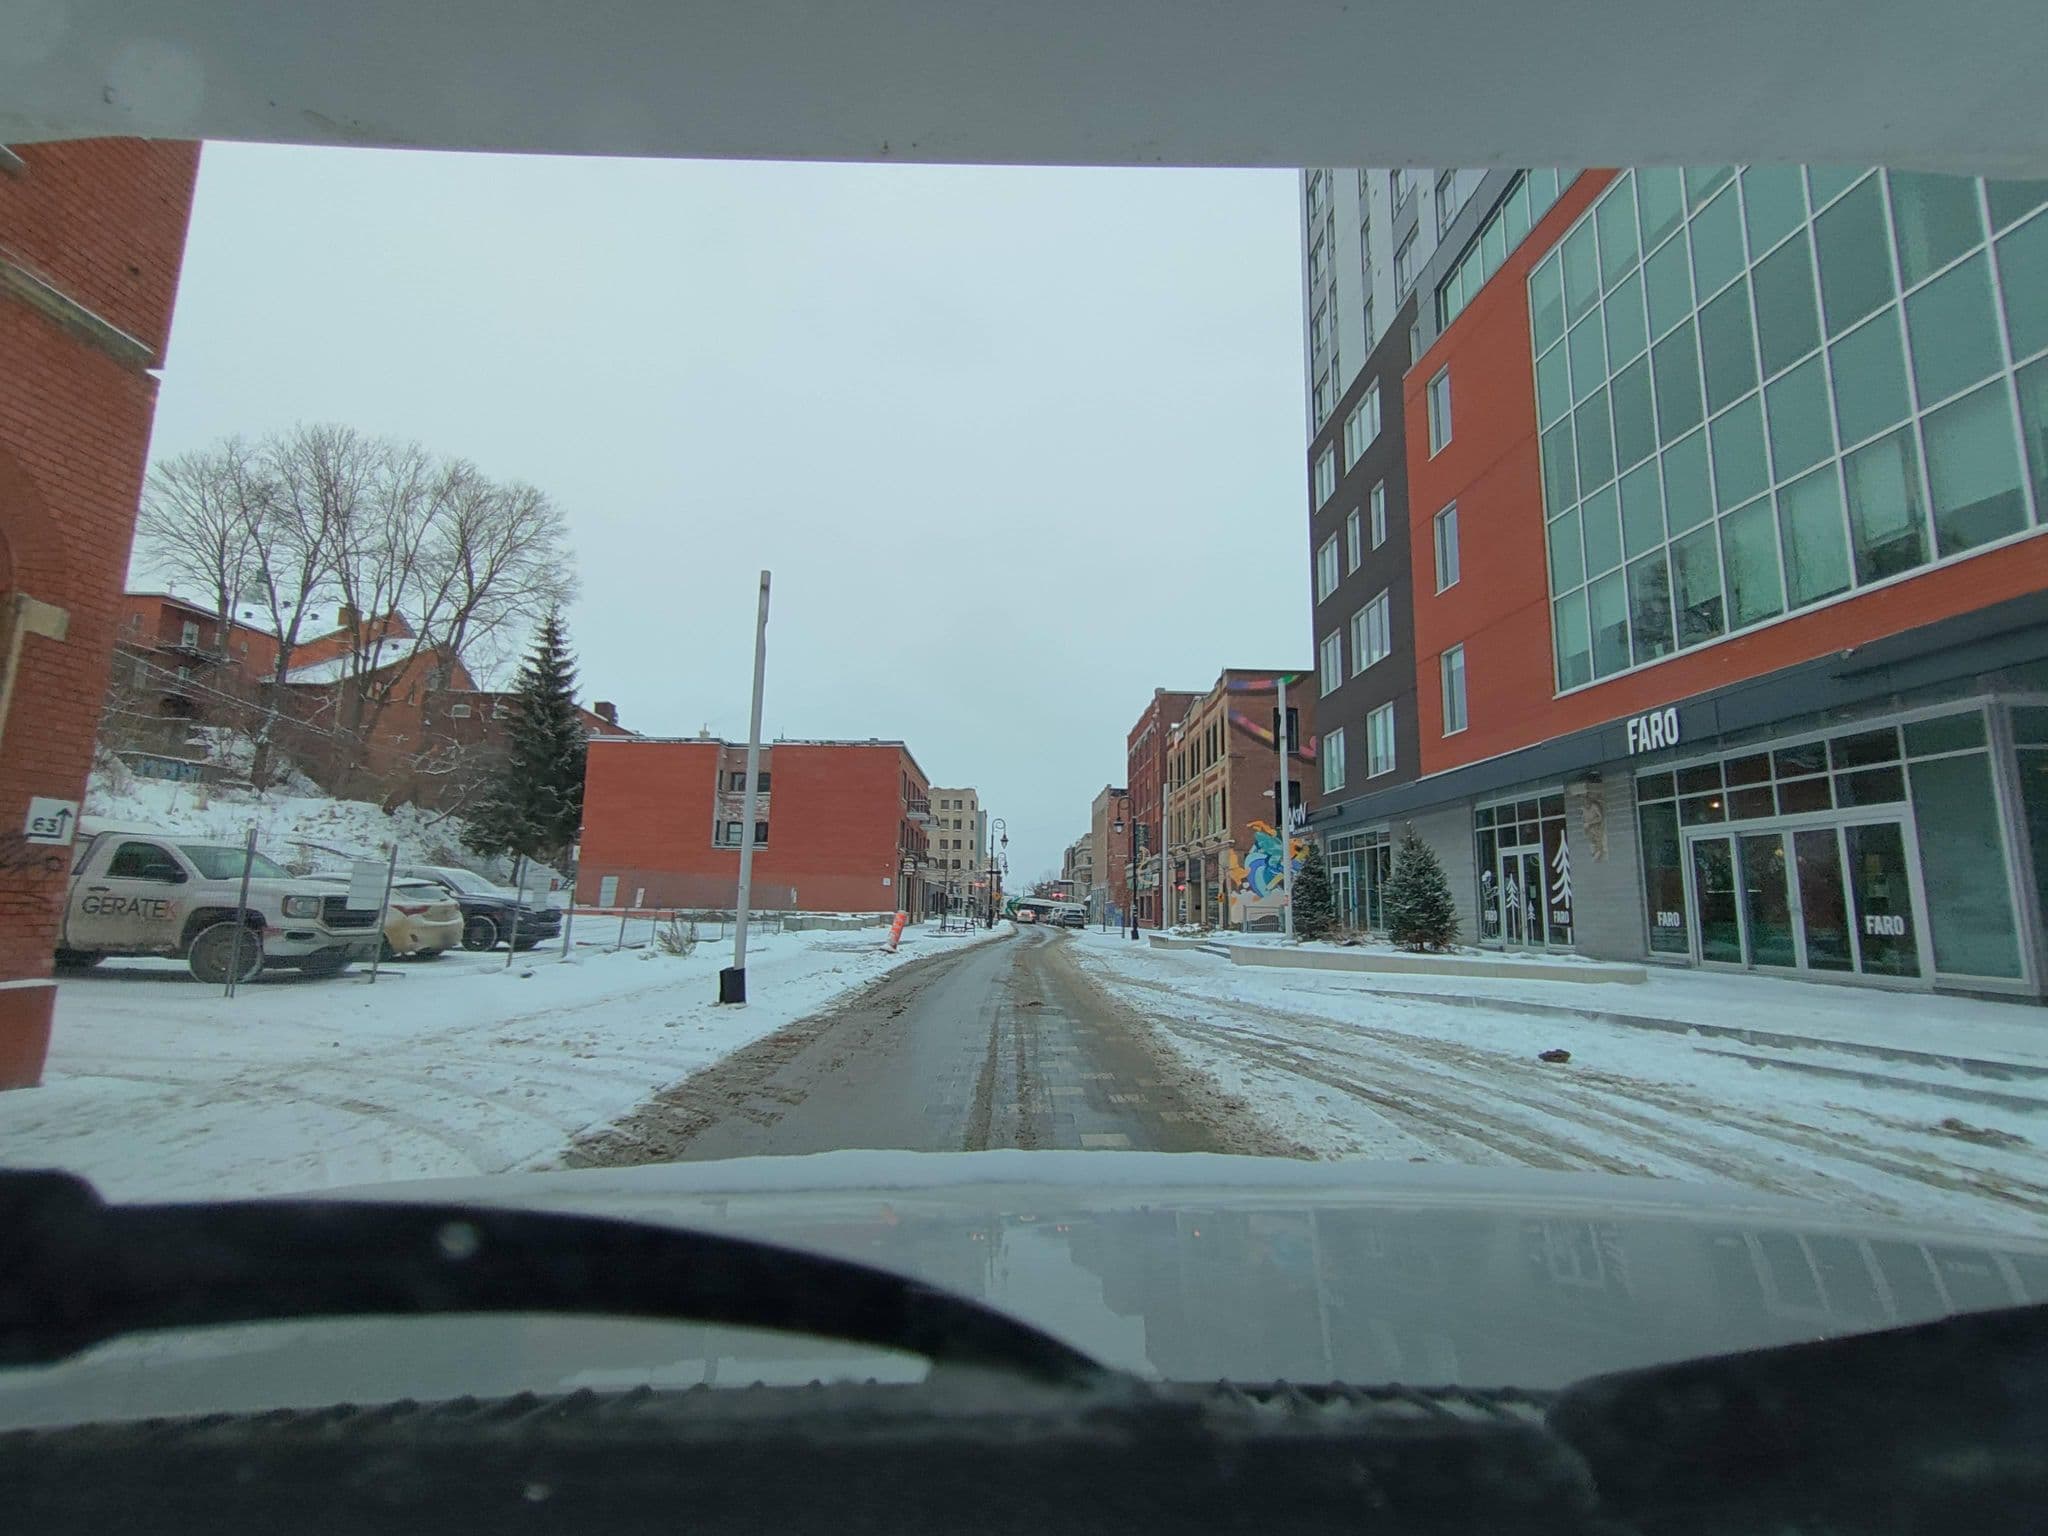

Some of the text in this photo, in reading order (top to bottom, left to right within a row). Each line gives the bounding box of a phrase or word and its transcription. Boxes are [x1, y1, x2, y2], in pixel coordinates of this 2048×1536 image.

[1627, 707, 1679, 755] FARO
[1553, 910, 1570, 924] FARO
[1657, 911, 1680, 927] FARO
[1865, 915, 1905, 936] FARO
